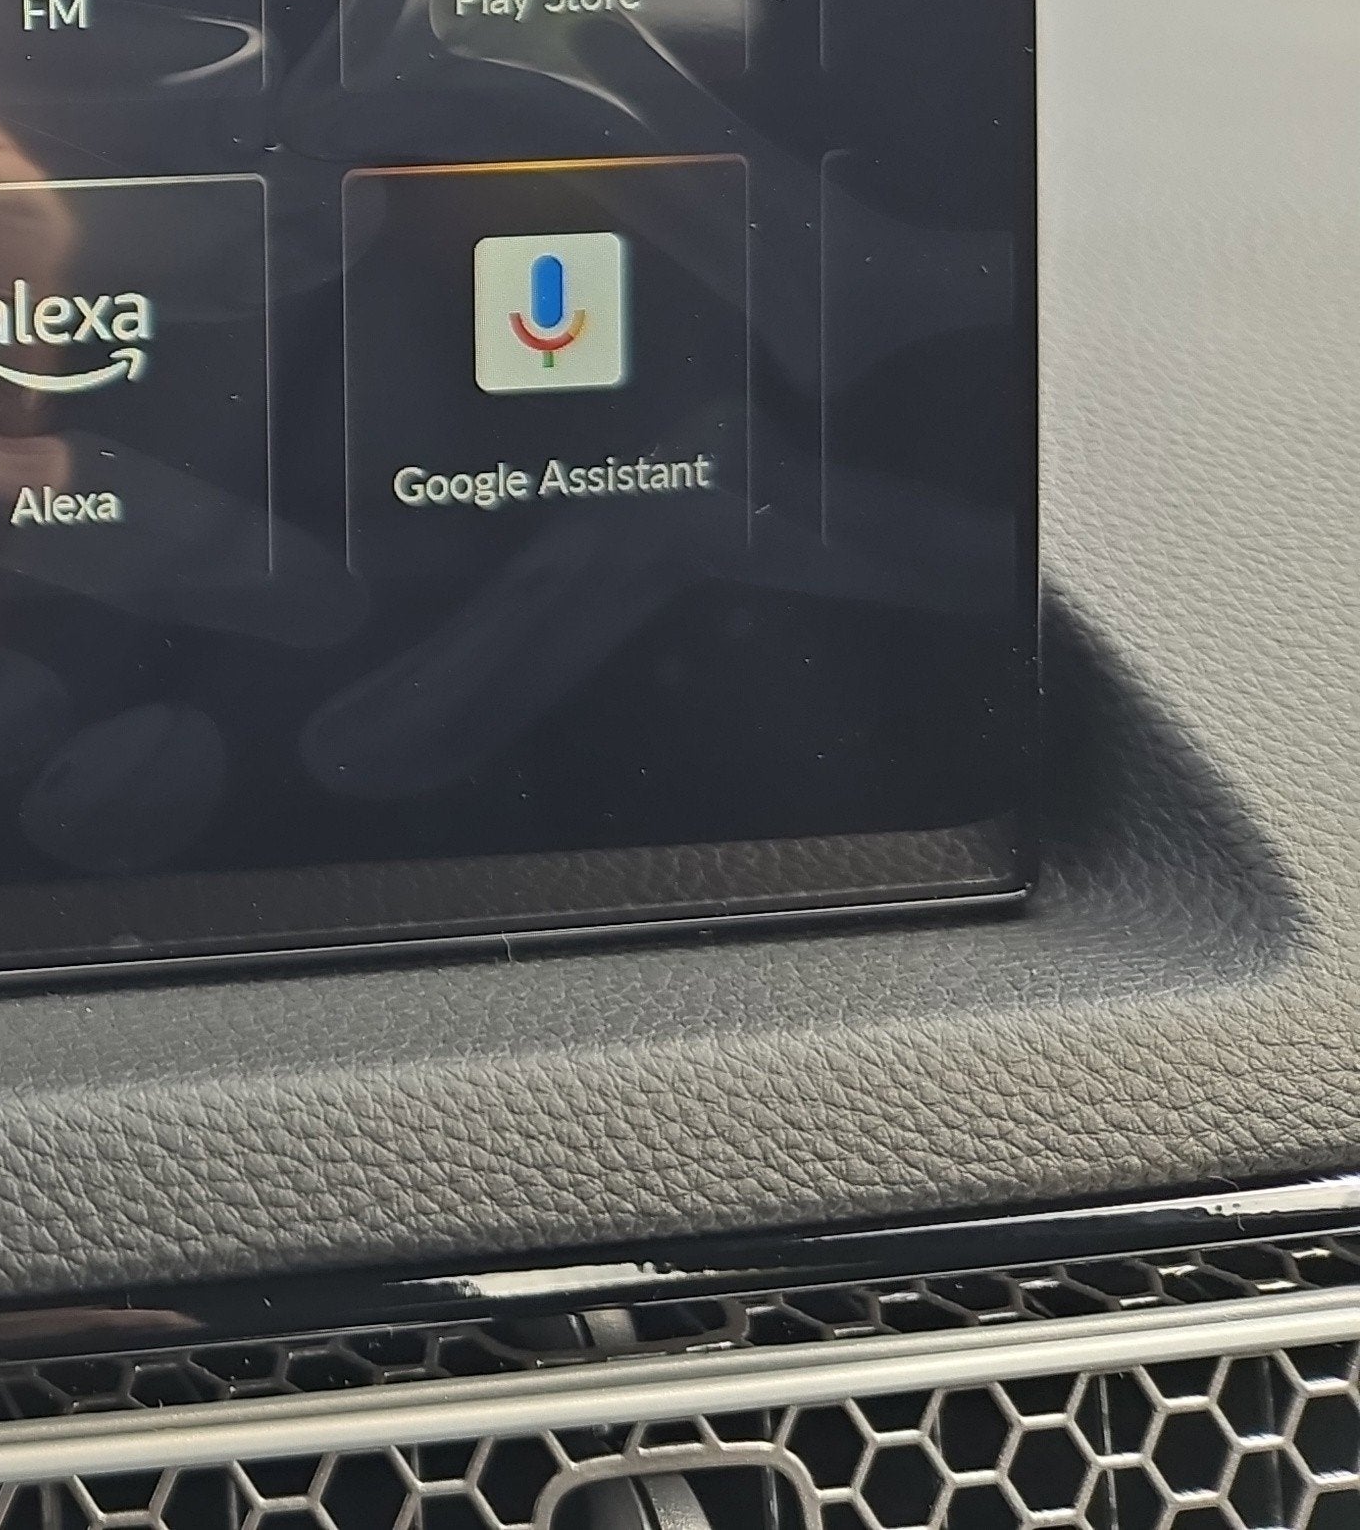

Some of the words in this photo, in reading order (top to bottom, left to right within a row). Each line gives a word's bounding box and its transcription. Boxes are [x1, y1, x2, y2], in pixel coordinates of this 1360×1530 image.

[10, 484, 122, 528] Alexa
[392, 463, 531, 510] Google
[538, 453, 711, 497] Assistant
